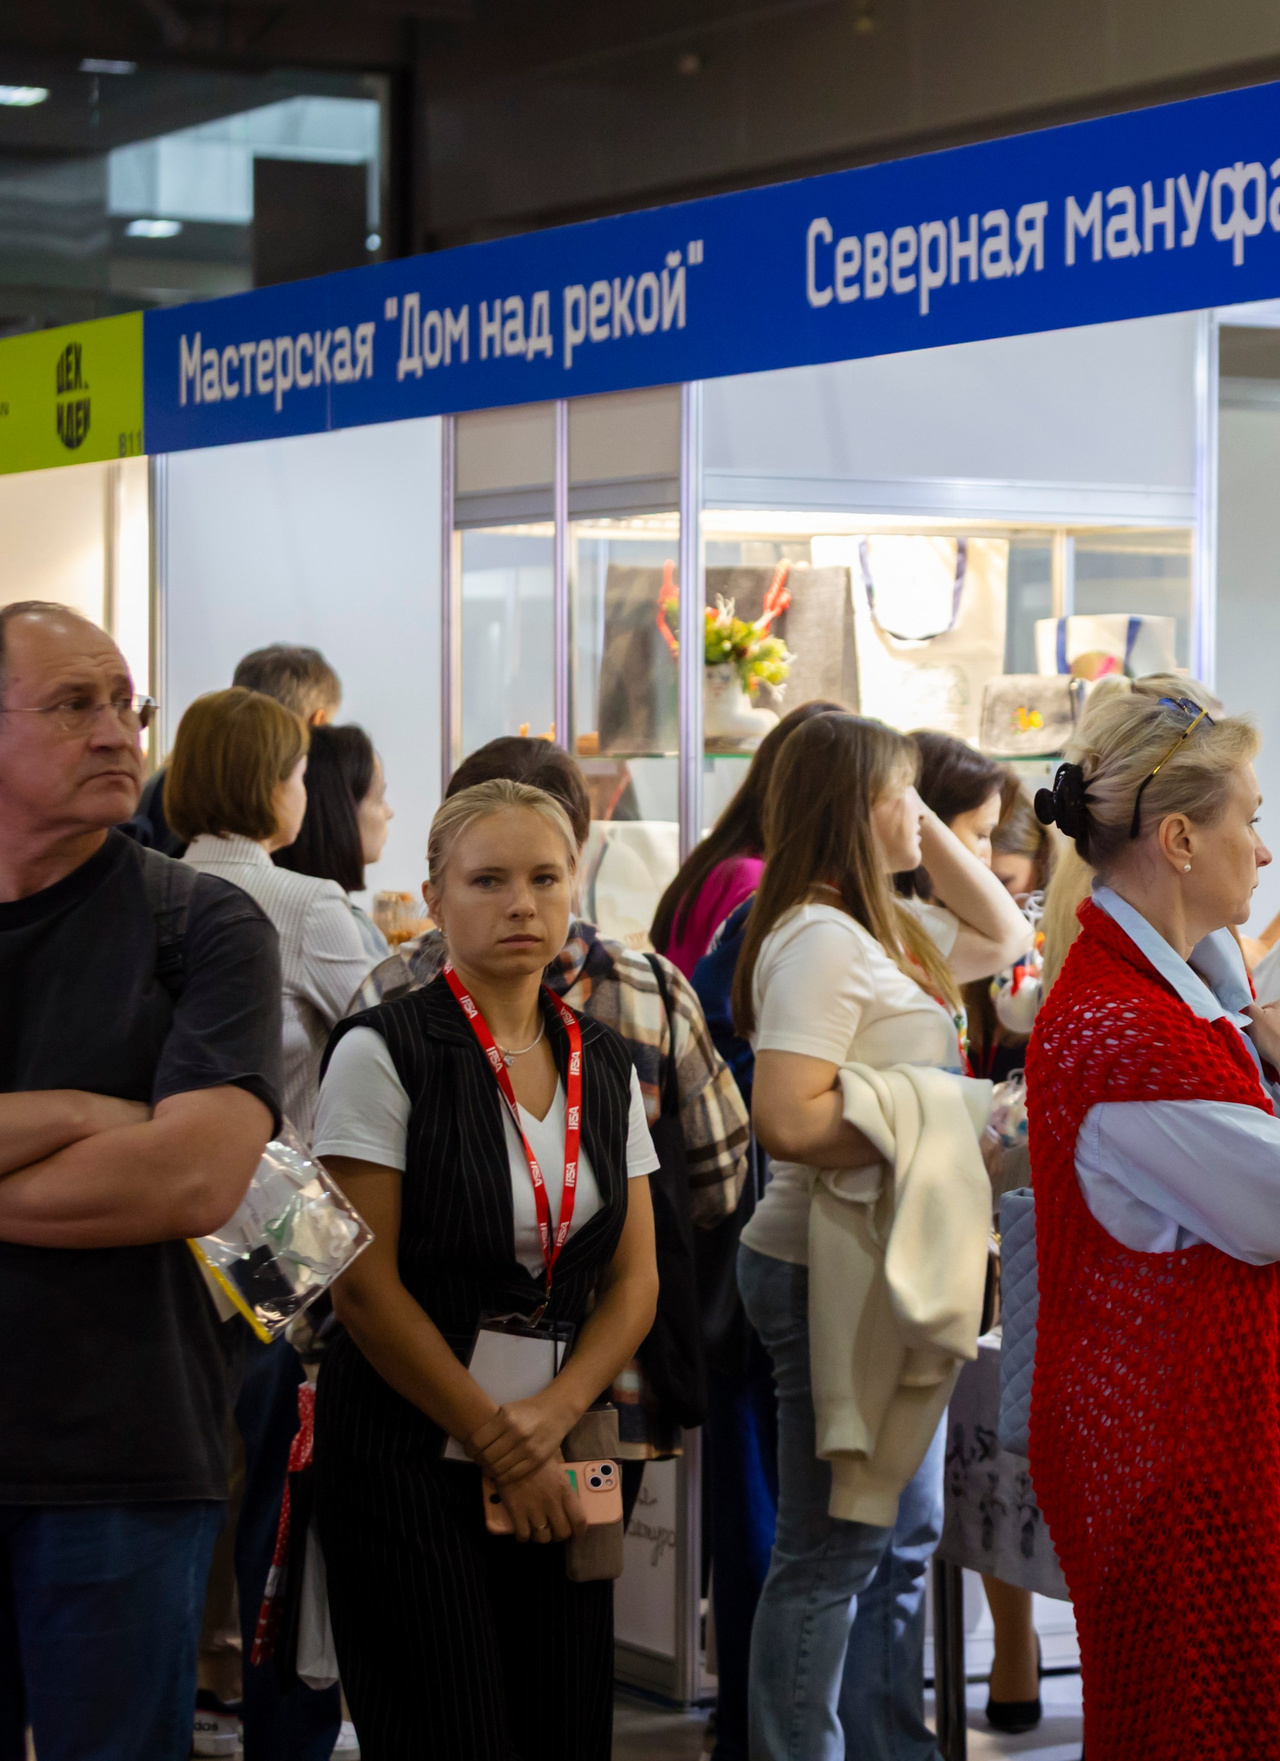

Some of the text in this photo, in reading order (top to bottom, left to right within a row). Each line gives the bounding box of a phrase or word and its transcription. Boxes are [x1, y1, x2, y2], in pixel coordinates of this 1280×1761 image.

[179, 239, 704, 412] Мастерская "Дом над рекой"
[806, 201, 1048, 316] Северная
